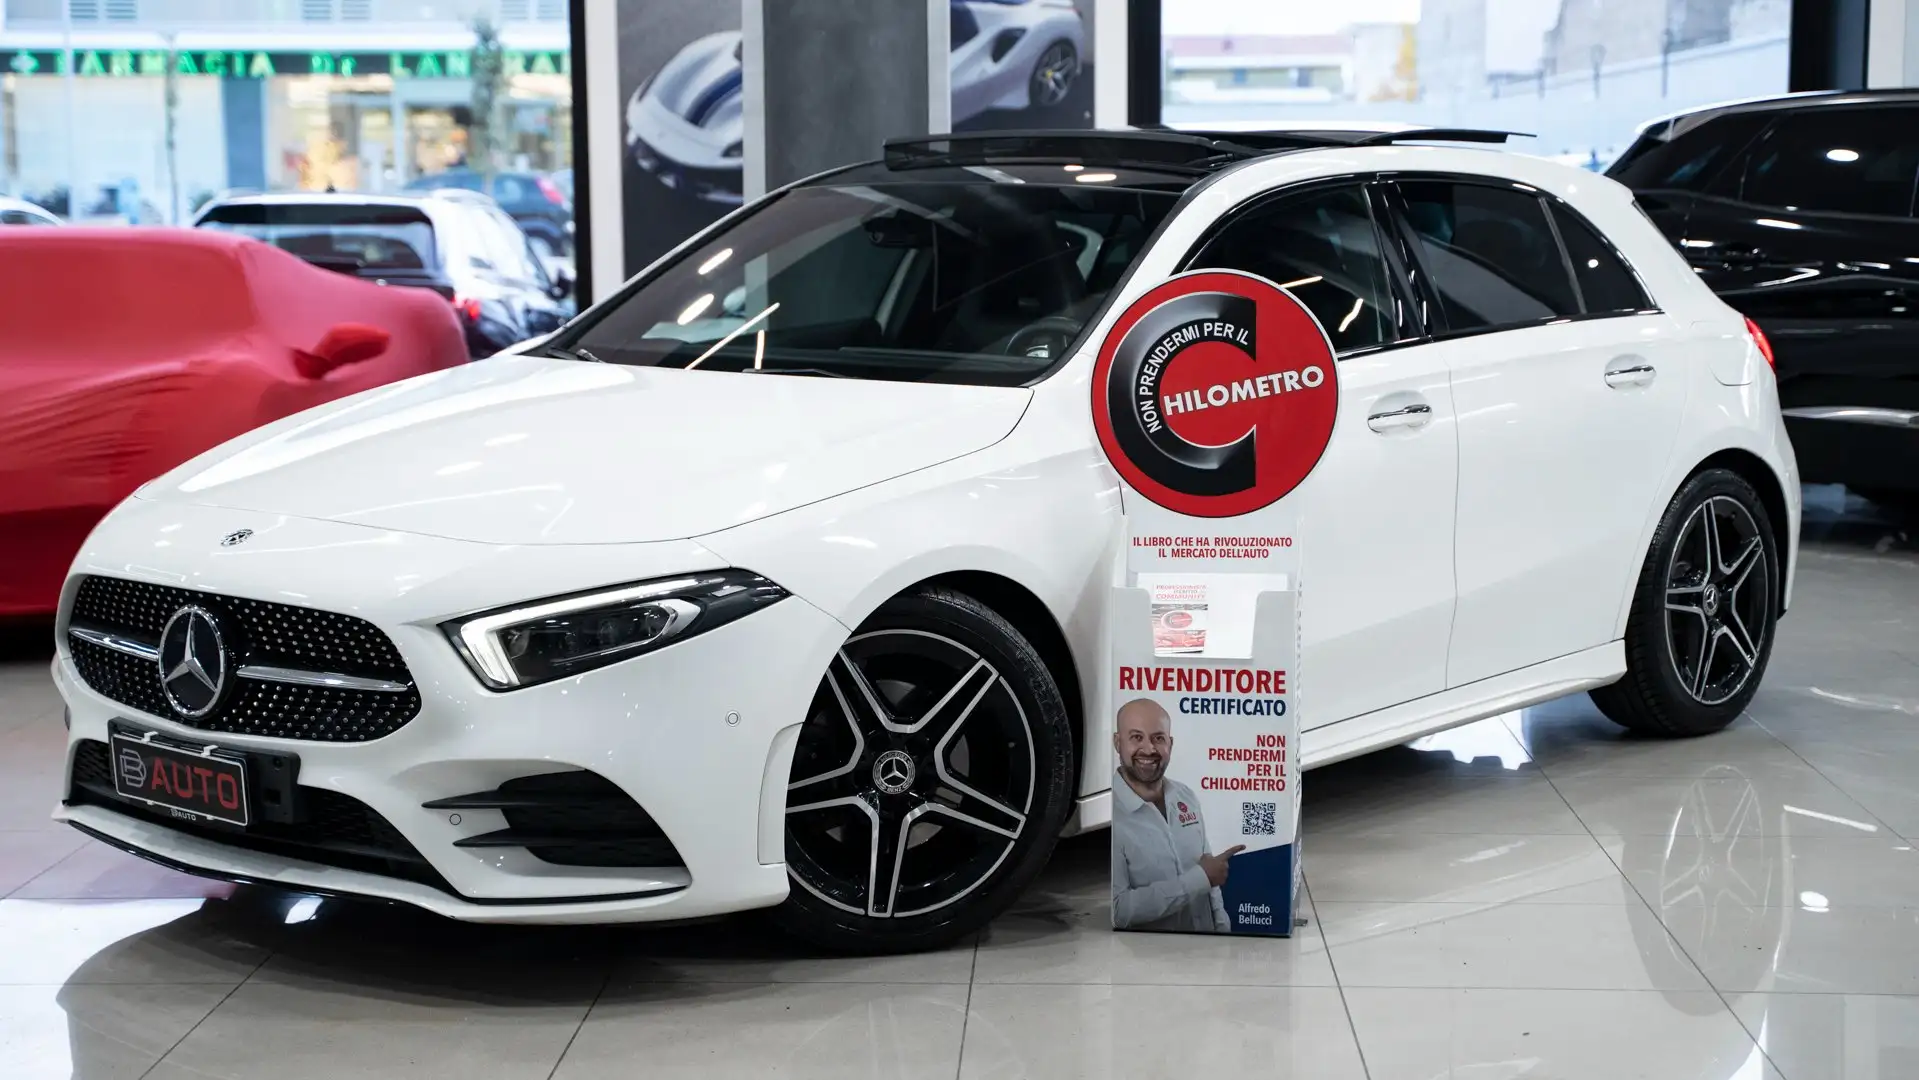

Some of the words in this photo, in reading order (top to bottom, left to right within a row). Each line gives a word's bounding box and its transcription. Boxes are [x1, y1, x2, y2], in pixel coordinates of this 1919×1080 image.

[1203, 322, 1234, 338] PER
[1236, 328, 1250, 346] IL
[1140, 325, 1200, 396] PRENDERMI
[1140, 400, 1162, 433] NON
[1133, 537, 1142, 546] IL
[1143, 537, 1173, 547] LIBRO
[1174, 537, 1193, 547] CHE
[1196, 537, 1210, 547] HA
[1214, 537, 1293, 547] RIVOLUZIONATO
[1158, 548, 1167, 558] IL
[1171, 548, 1217, 558] MERCATO
[1219, 548, 1269, 559] DELL'AUTO
[1119, 666, 1286, 694] RIVENDITORE
[1179, 697, 1286, 716] CERTIFICATO
[1256, 734, 1286, 747] NON
[1208, 748, 1286, 763] PRENDERMI
[1247, 764, 1271, 776] PER
[1275, 764, 1286, 777] IL
[151, 757, 239, 810] AUTO
[1201, 777, 1286, 792] CHILOMETRO
[1238, 903, 1271, 914] Alfredo
[1238, 914, 1273, 926] Bellucci
